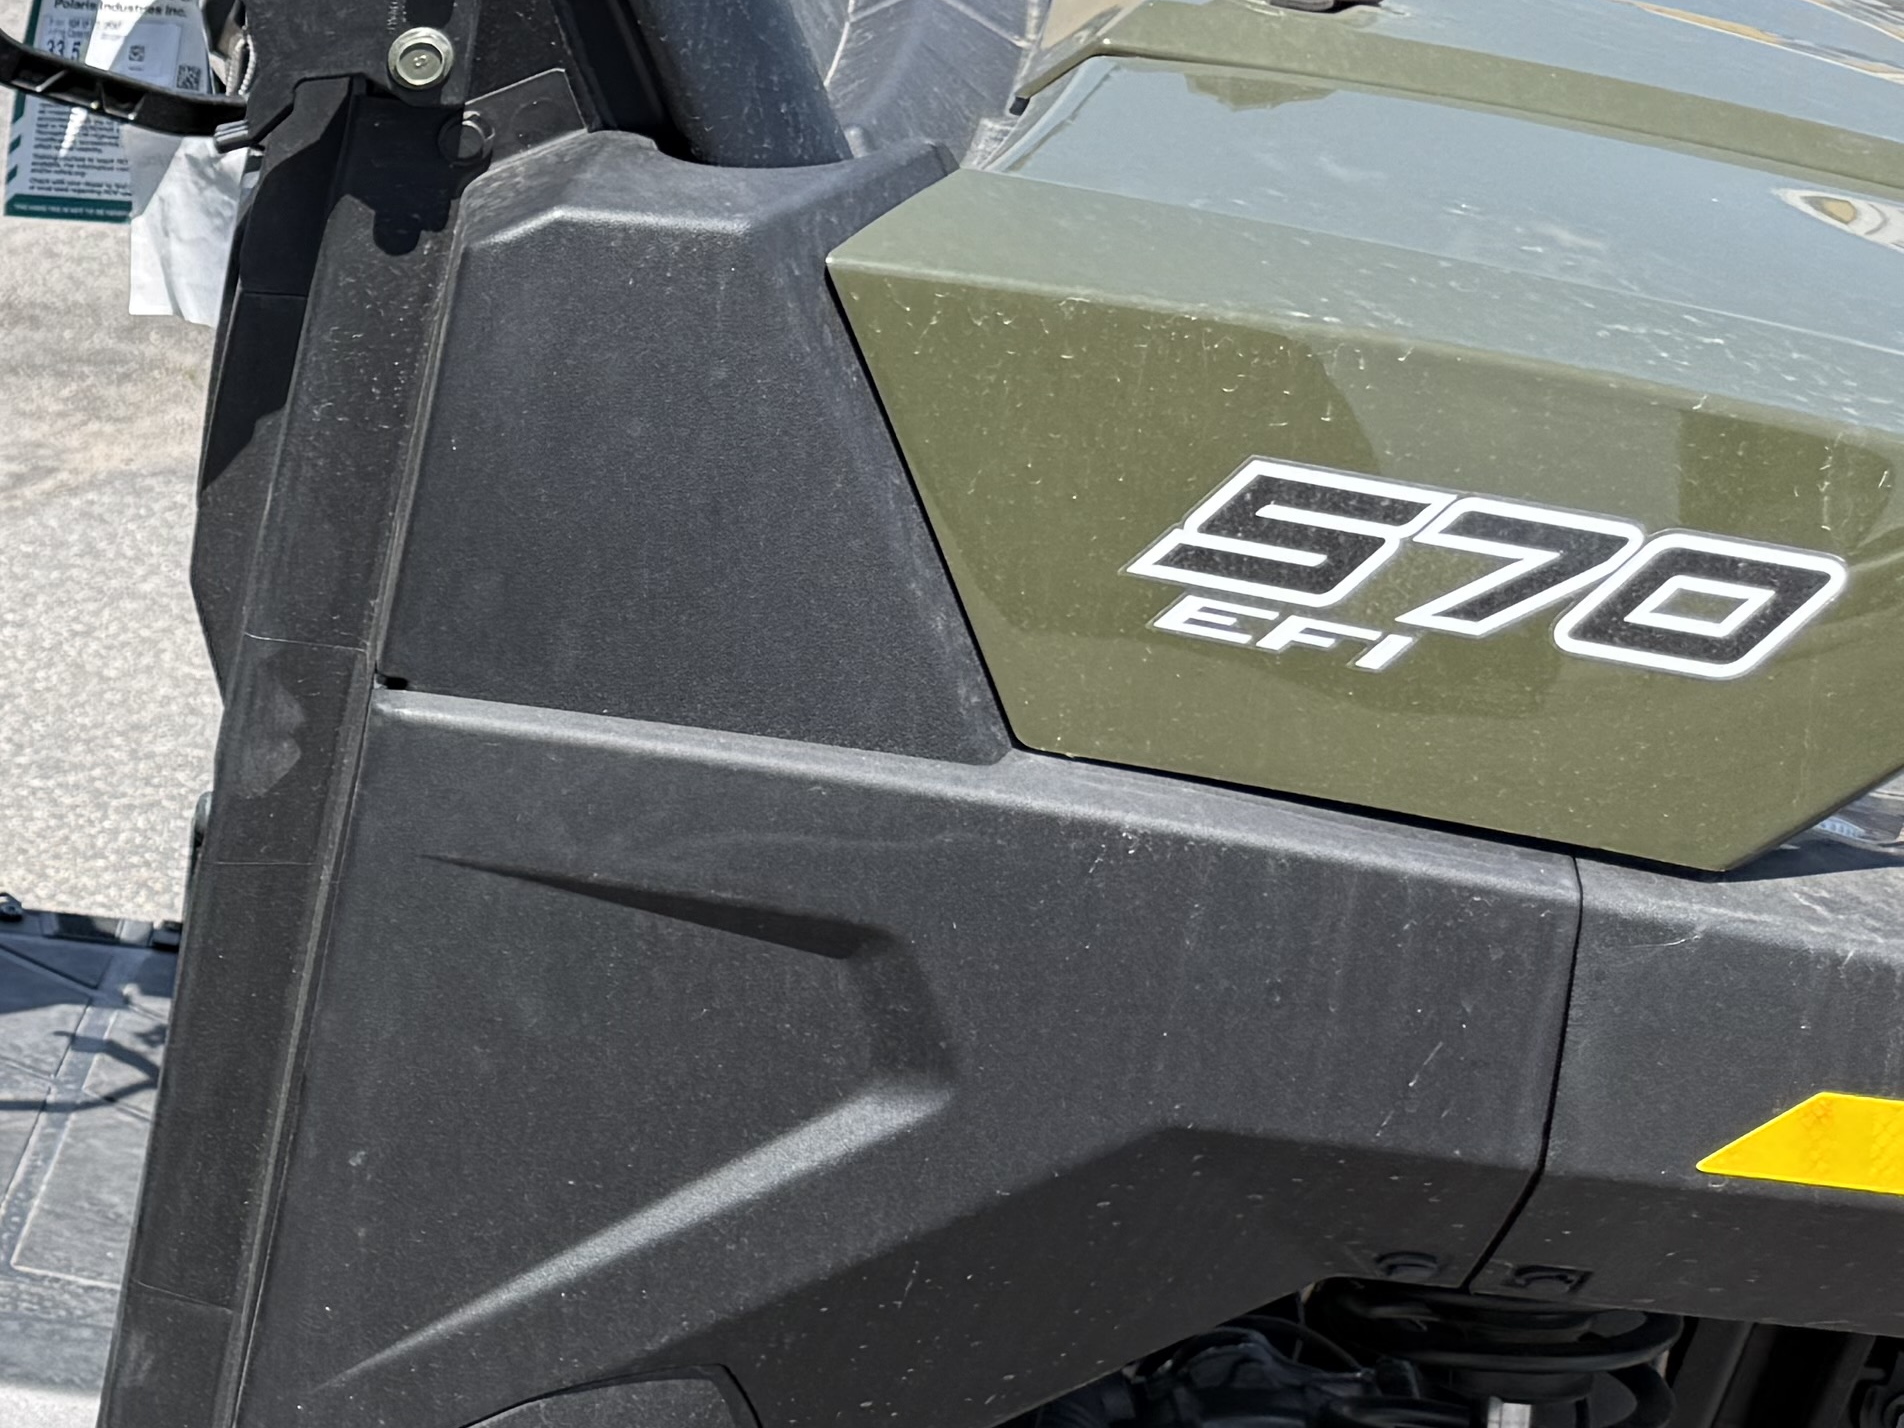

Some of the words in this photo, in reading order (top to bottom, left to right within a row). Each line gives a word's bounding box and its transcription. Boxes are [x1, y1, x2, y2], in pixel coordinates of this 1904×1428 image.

[98, 1, 162, 15] Industries
[164, 4, 188, 18] Inc.
[1123, 458, 1848, 679] 570
[1153, 594, 1414, 670] EFI
